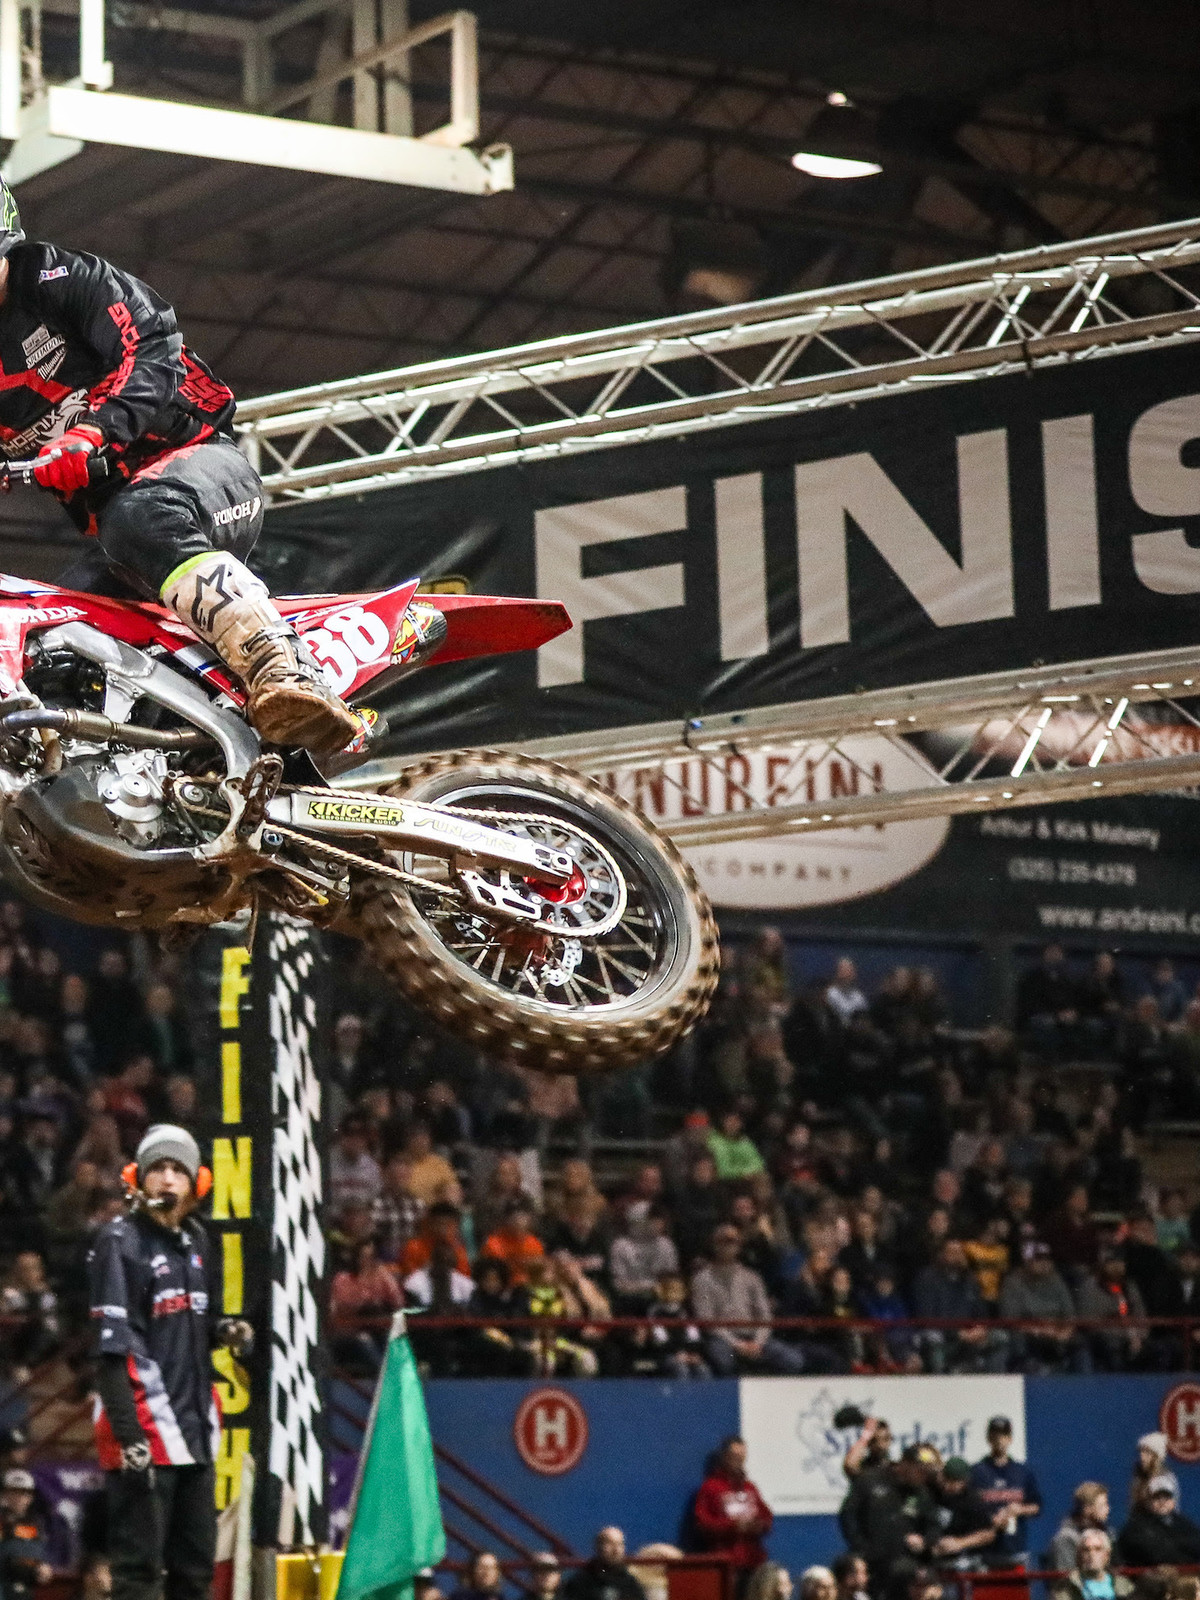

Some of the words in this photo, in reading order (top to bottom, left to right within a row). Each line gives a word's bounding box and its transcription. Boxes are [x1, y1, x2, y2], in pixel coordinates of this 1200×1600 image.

[213, 501, 251, 526] HONDA
[300, 606, 390, 696] 38
[605, 754, 883, 817] NDREINI
[316, 815, 371, 824] PERFORMANCE
[373, 818, 396, 826] AUDIO
[326, 803, 403, 822] KICKER
[211, 946, 253, 1509] FINISH
[535, 1406, 568, 1448] H
